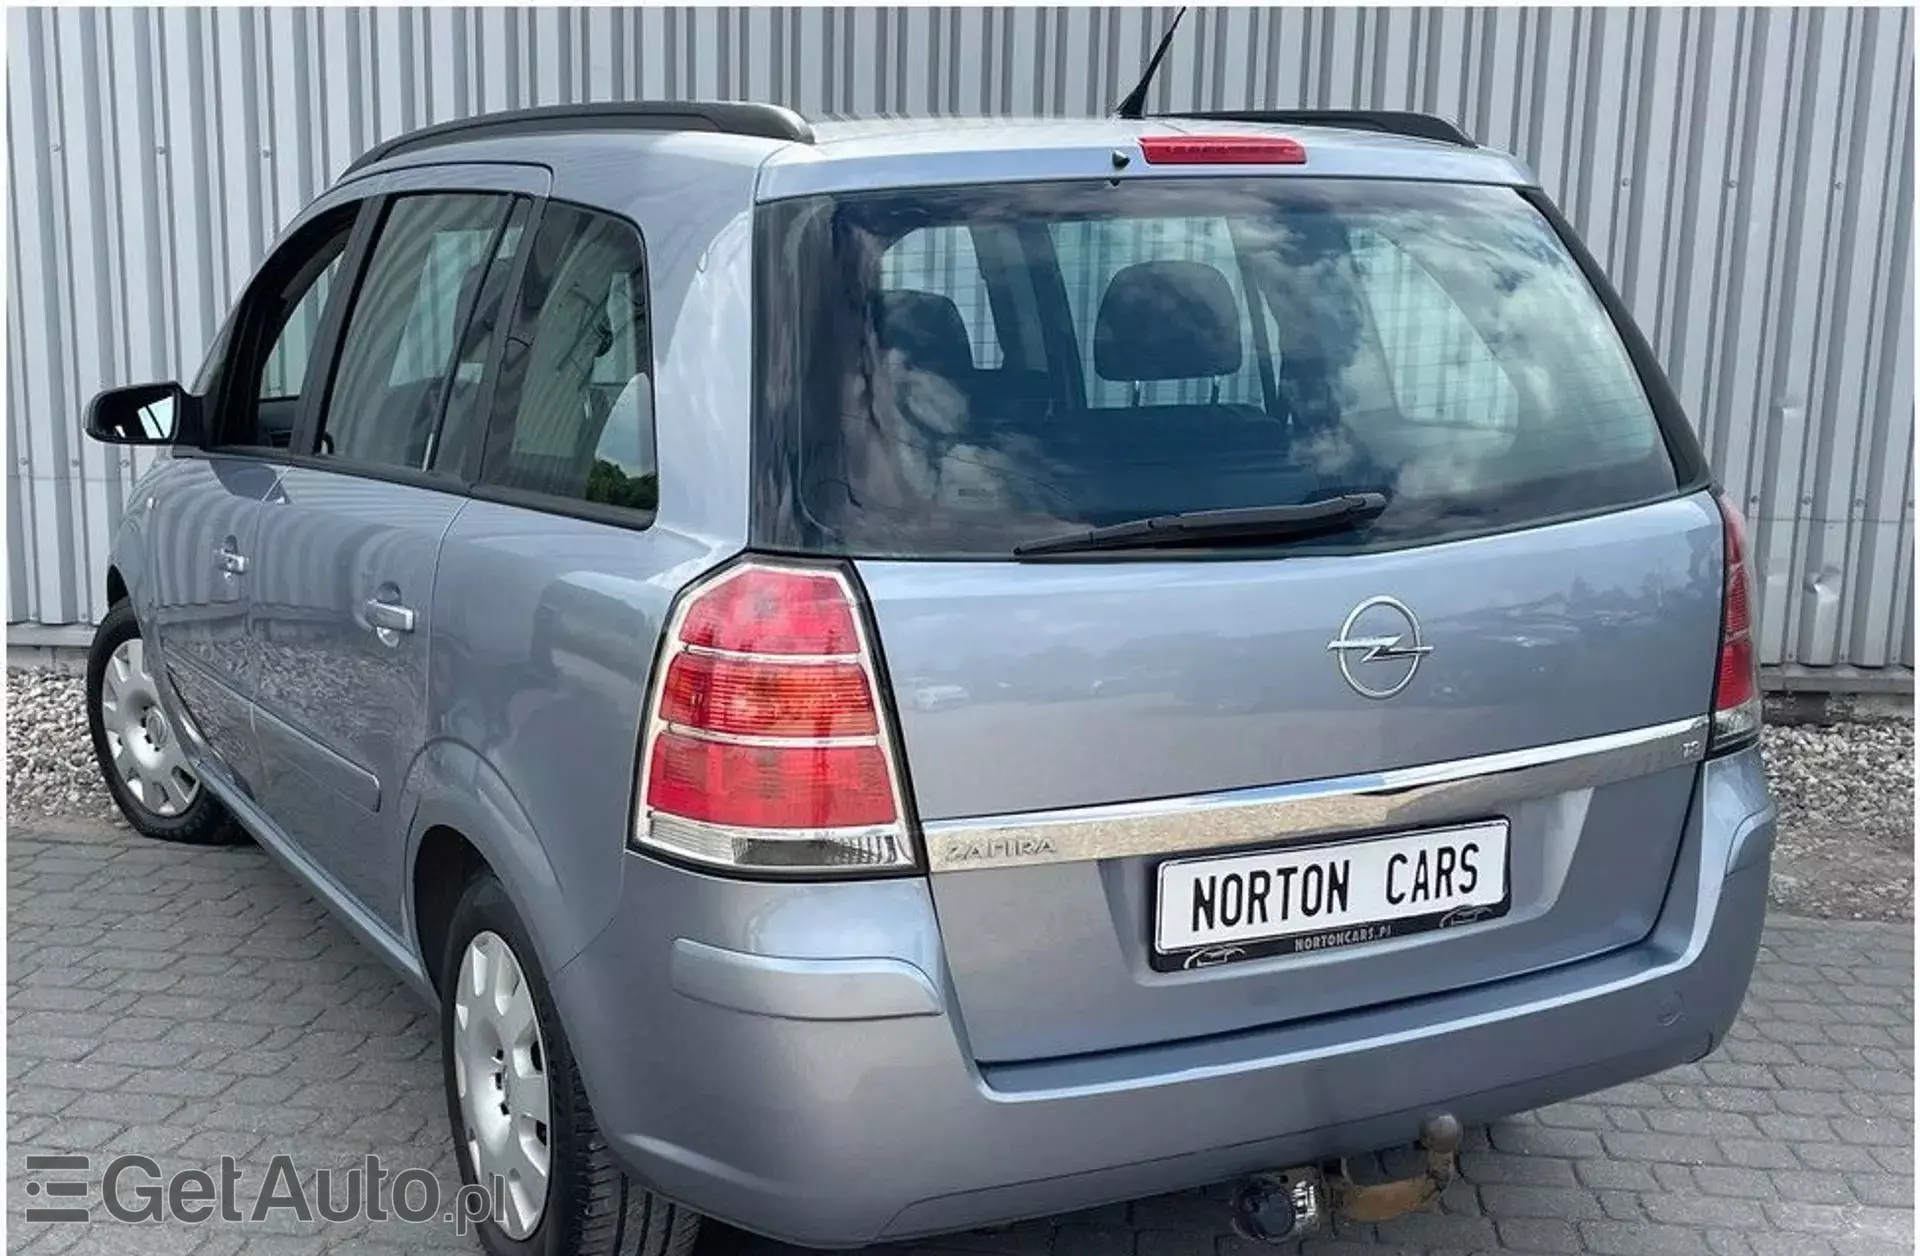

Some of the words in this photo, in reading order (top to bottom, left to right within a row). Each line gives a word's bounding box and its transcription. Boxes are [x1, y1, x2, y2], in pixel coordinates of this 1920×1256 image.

[946, 837, 1057, 862] ZAFIRA
[1191, 860, 1351, 931] NORTON
[1385, 843, 1480, 906] CARS
